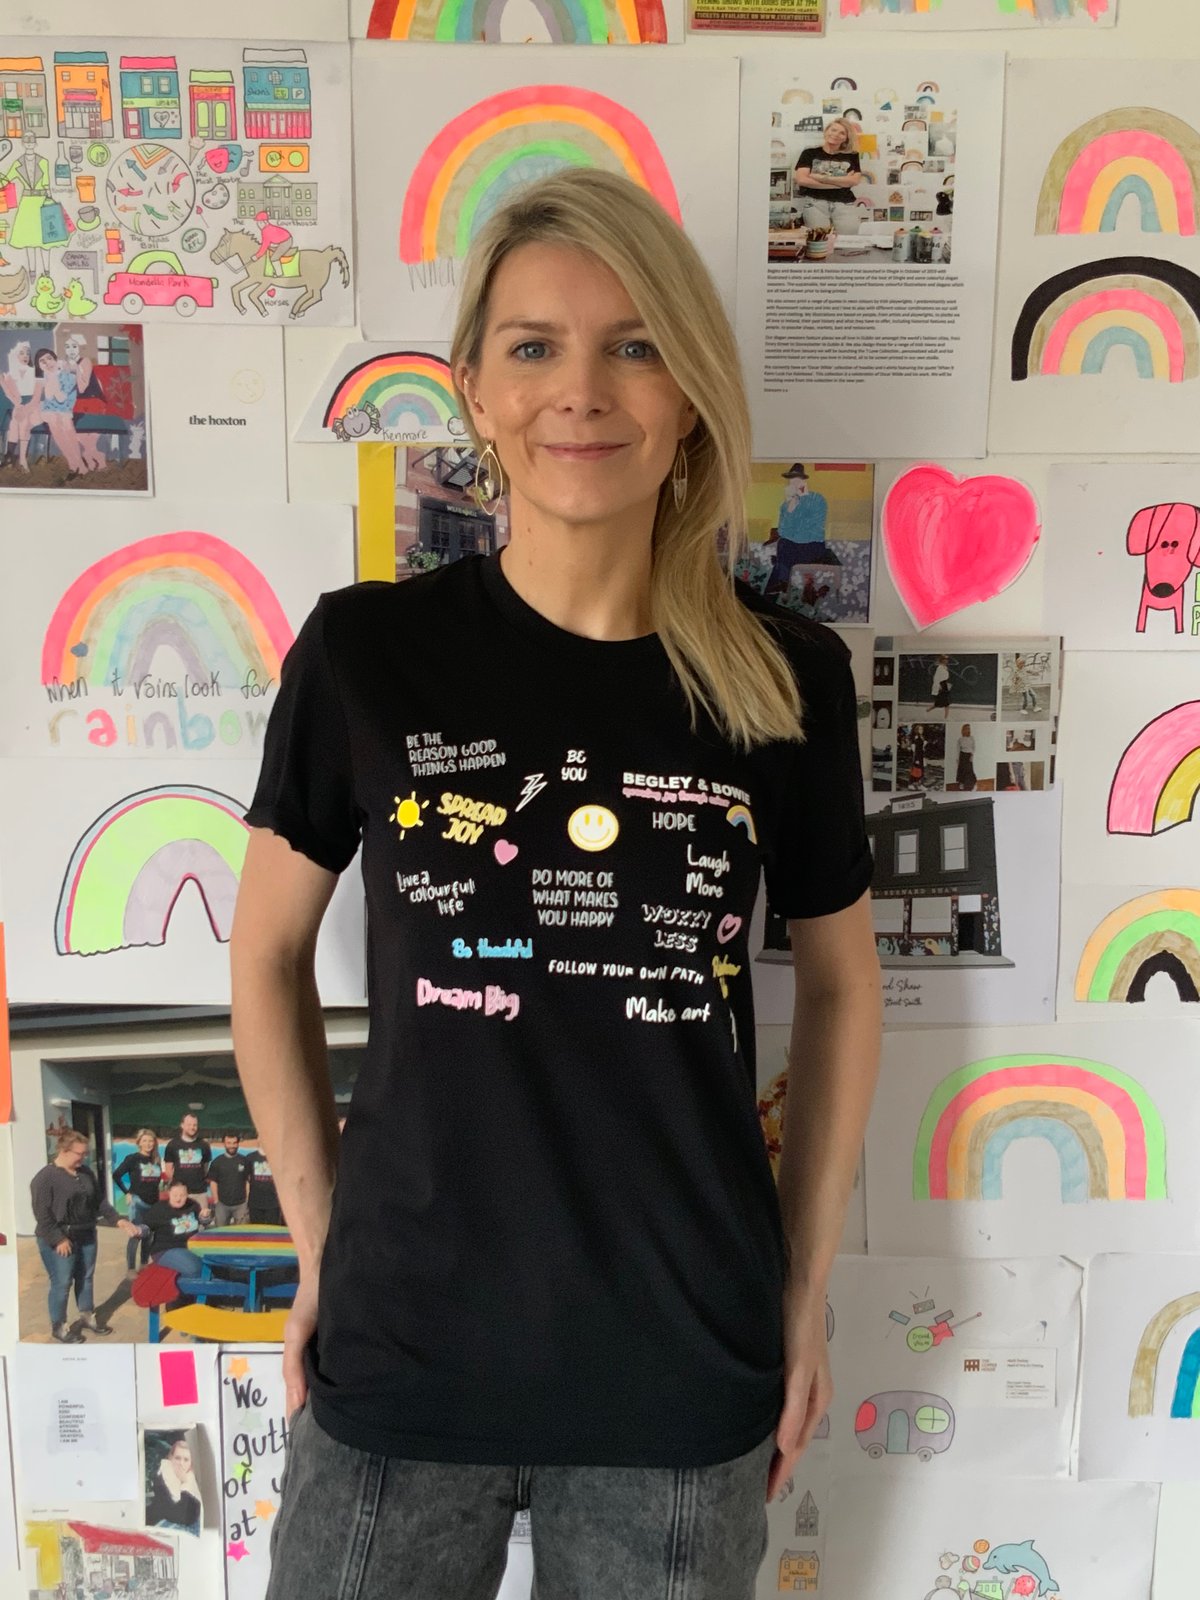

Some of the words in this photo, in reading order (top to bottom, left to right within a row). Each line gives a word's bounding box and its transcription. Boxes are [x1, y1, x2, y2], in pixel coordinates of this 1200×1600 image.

[189, 415, 207, 426] the
[208, 415, 247, 426] hoxton
[184, 671, 222, 699] look
[406, 734, 420, 749] BE
[422, 732, 443, 746] THE
[408, 745, 458, 763] REASON
[461, 739, 497, 756] GOOD
[411, 759, 457, 777] THINGS
[459, 752, 507, 772] HAPPEN
[566, 749, 587, 764] BE
[561, 766, 588, 782] YOU
[623, 772, 693, 789] BEGLEY
[698, 778, 708, 791] &
[711, 782, 751, 806] BOWIE
[436, 792, 507, 826] SPREAD
[652, 811, 697, 832] HOPE
[442, 818, 484, 845] JOY
[687, 844, 731, 878] Laugh
[396, 871, 420, 893] Live
[409, 878, 476, 903] colourful
[532, 869, 552, 885] DO
[555, 870, 593, 888] MORE
[597, 872, 614, 888] OF
[685, 872, 724, 898] More
[438, 899, 465, 917] life
[532, 889, 572, 906] WHAT
[574, 891, 619, 908] MAKES
[537, 909, 567, 926] YOU
[570, 911, 615, 927] HAPPY
[548, 959, 598, 976] FOLLOW
[602, 963, 634, 977] YOUR
[639, 966, 668, 981] OWN
[670, 966, 704, 985] PATH
[416, 977, 483, 1010] Dream
[484, 985, 520, 1021] Big
[625, 996, 676, 1023] Make
[681, 1002, 711, 1022] art
[224, 1466, 254, 1499] of
[230, 1509, 259, 1541] at
